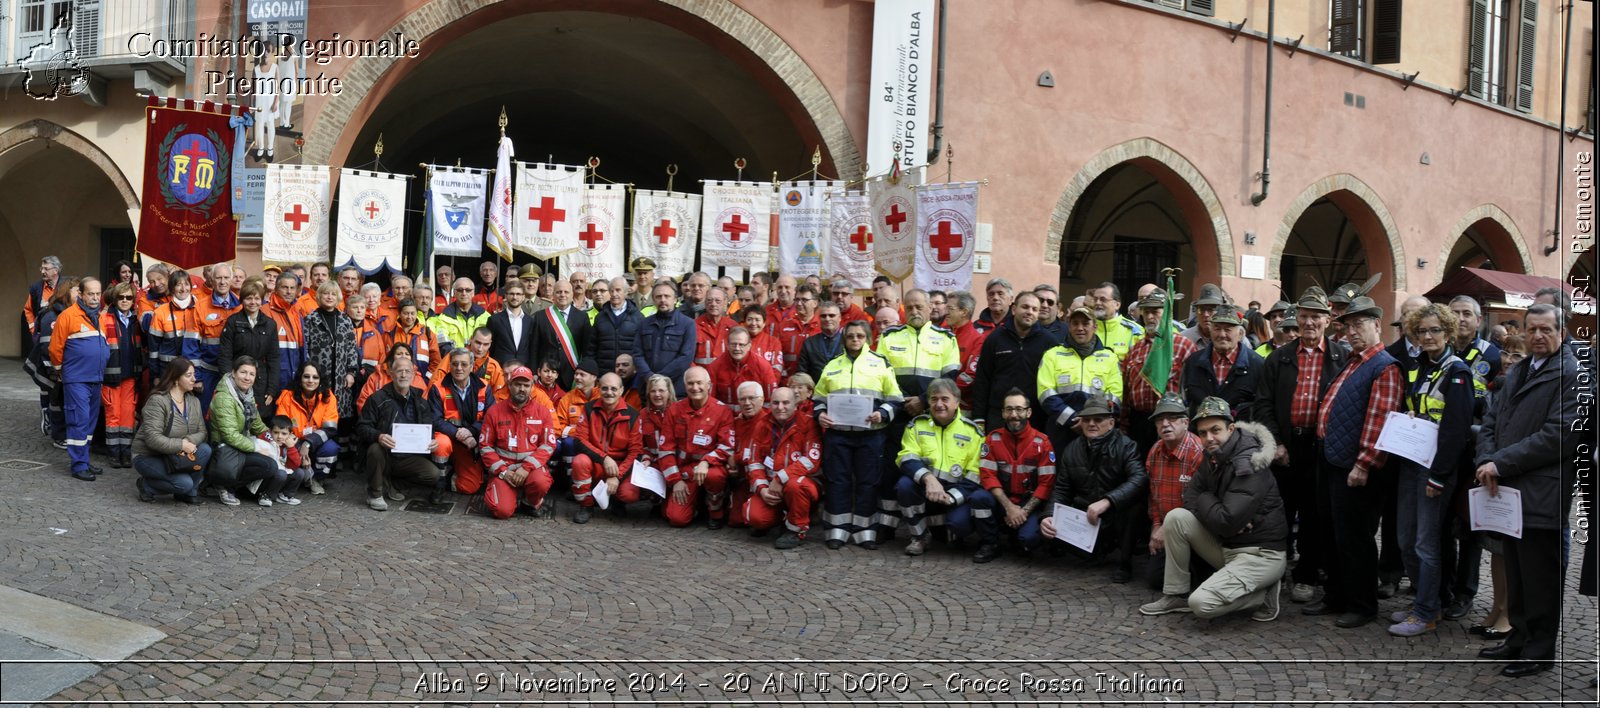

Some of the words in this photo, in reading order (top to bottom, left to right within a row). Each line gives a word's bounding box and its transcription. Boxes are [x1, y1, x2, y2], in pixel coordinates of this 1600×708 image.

[251, 0, 304, 19] CASORATI
[908, 10, 921, 60] D'ALBA
[906, 63, 918, 117] BIANCO
[524, 236, 566, 248] SUZZARA
[798, 231, 824, 239] ALBA
[933, 278, 957, 287] ALBA
